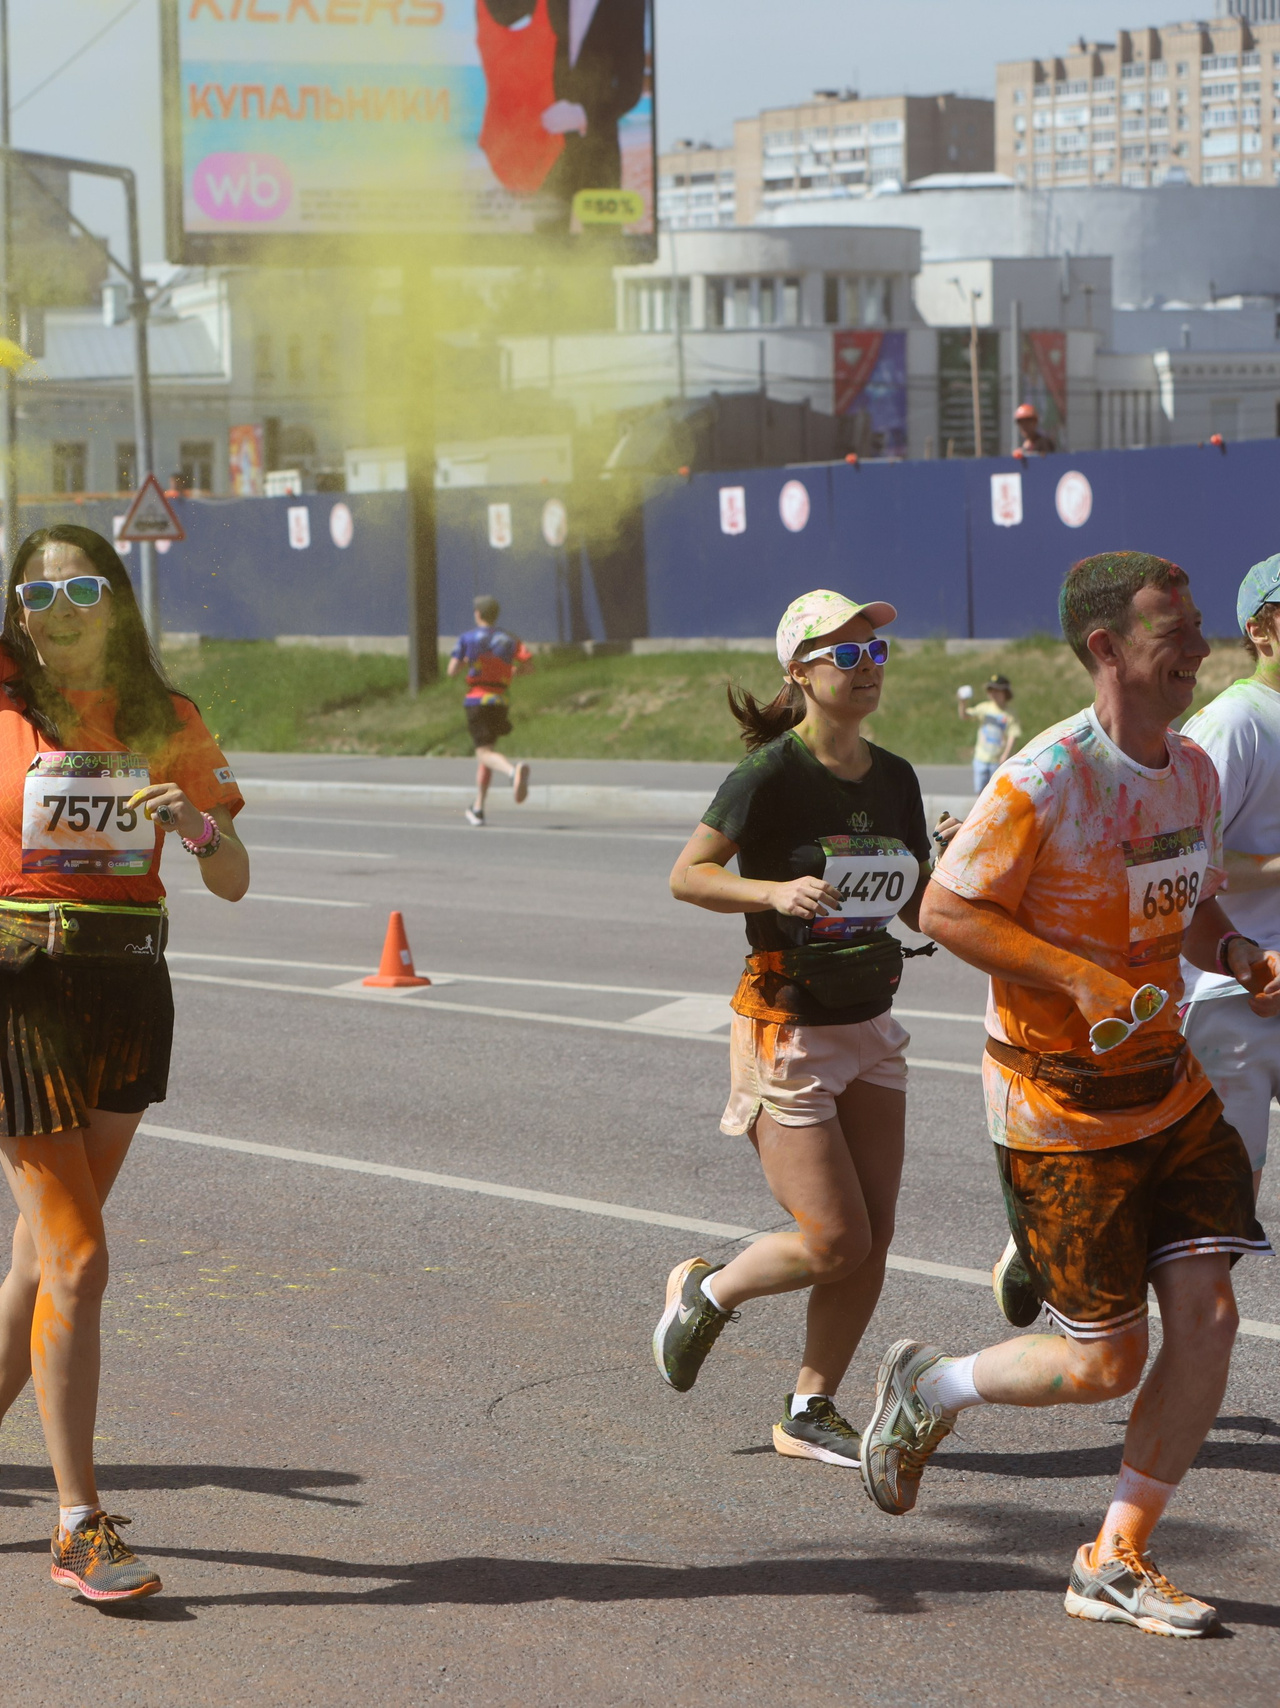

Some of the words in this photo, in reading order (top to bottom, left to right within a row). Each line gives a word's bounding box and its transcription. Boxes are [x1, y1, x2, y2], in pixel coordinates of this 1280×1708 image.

[187, 83, 452, 123] КУПАЛЬНИКИ
[206, 161, 281, 208] wb
[101, 769, 148, 778] 2026
[43, 795, 138, 832] 7575
[835, 871, 905, 902] 4470
[1143, 871, 1200, 921] 6388
